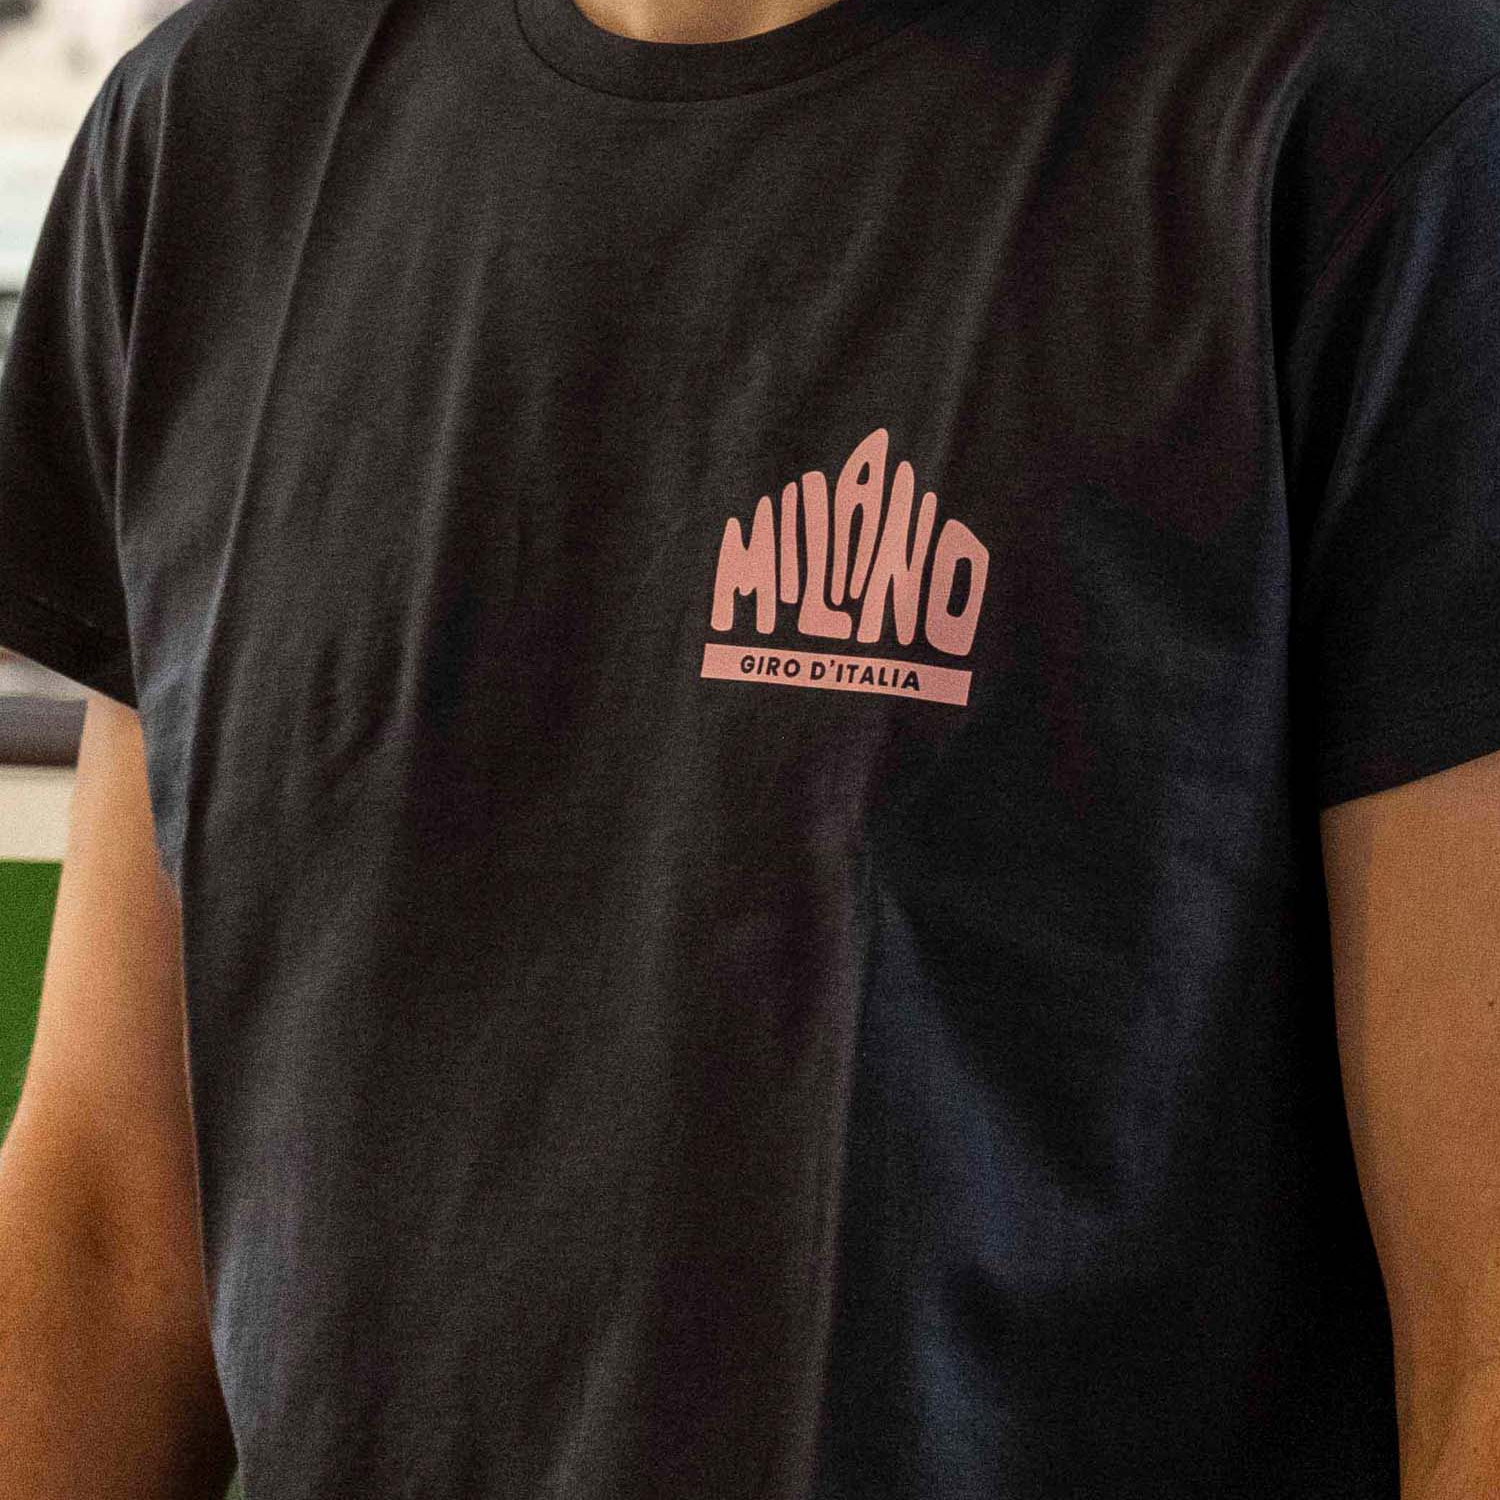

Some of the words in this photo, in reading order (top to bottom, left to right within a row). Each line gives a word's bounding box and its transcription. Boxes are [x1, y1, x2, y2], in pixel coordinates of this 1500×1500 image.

[710, 427, 990, 656] MILANO
[740, 654, 801, 678] GIRO
[810, 659, 921, 692] D'ITALIA
